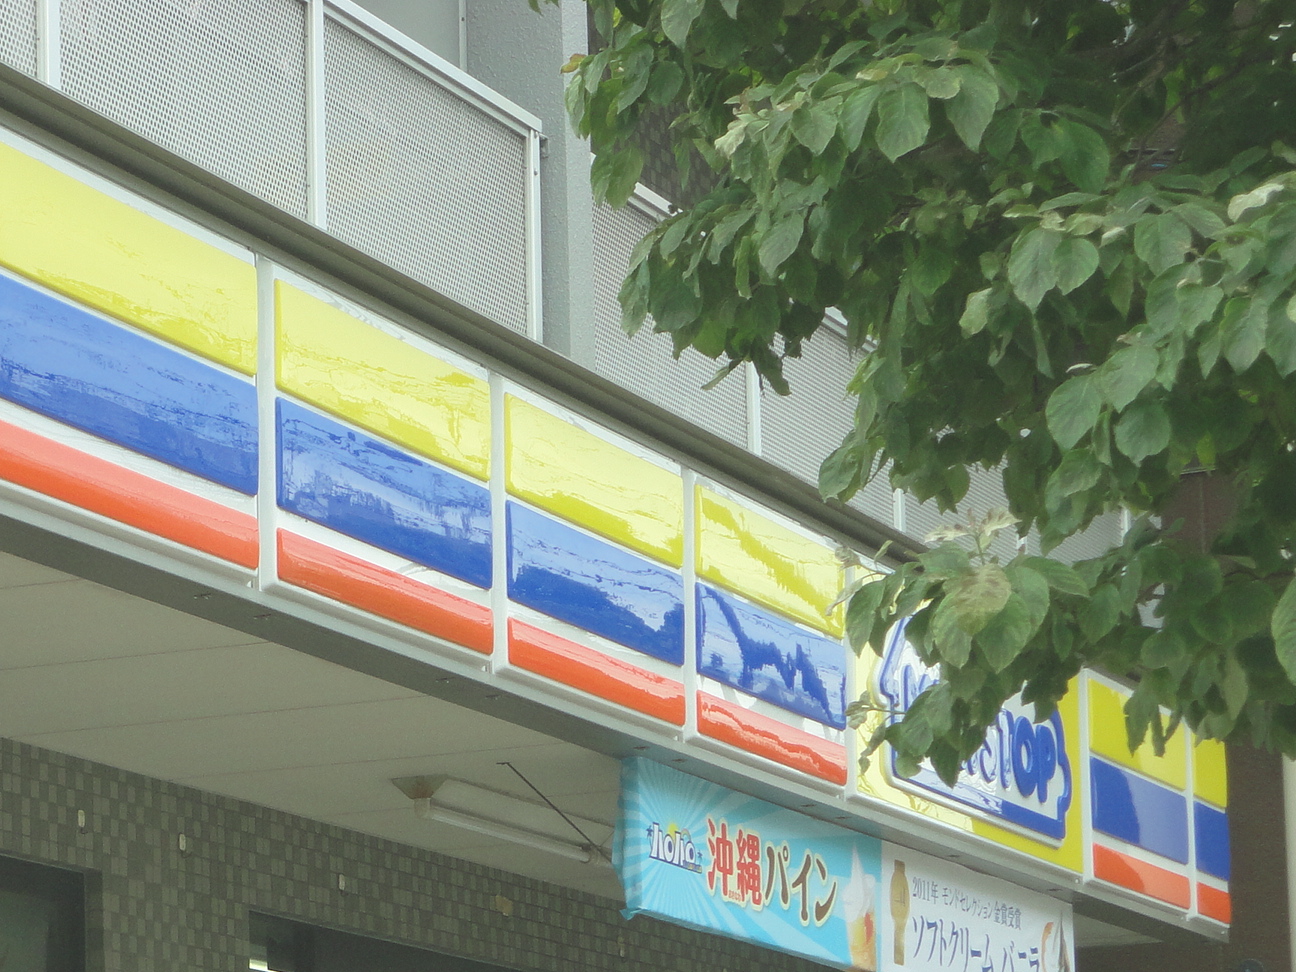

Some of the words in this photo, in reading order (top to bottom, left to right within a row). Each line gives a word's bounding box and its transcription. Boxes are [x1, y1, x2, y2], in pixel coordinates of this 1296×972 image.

[707, 817, 837, 922] 沖縄パイン
[912, 876, 939, 905] 2011年
